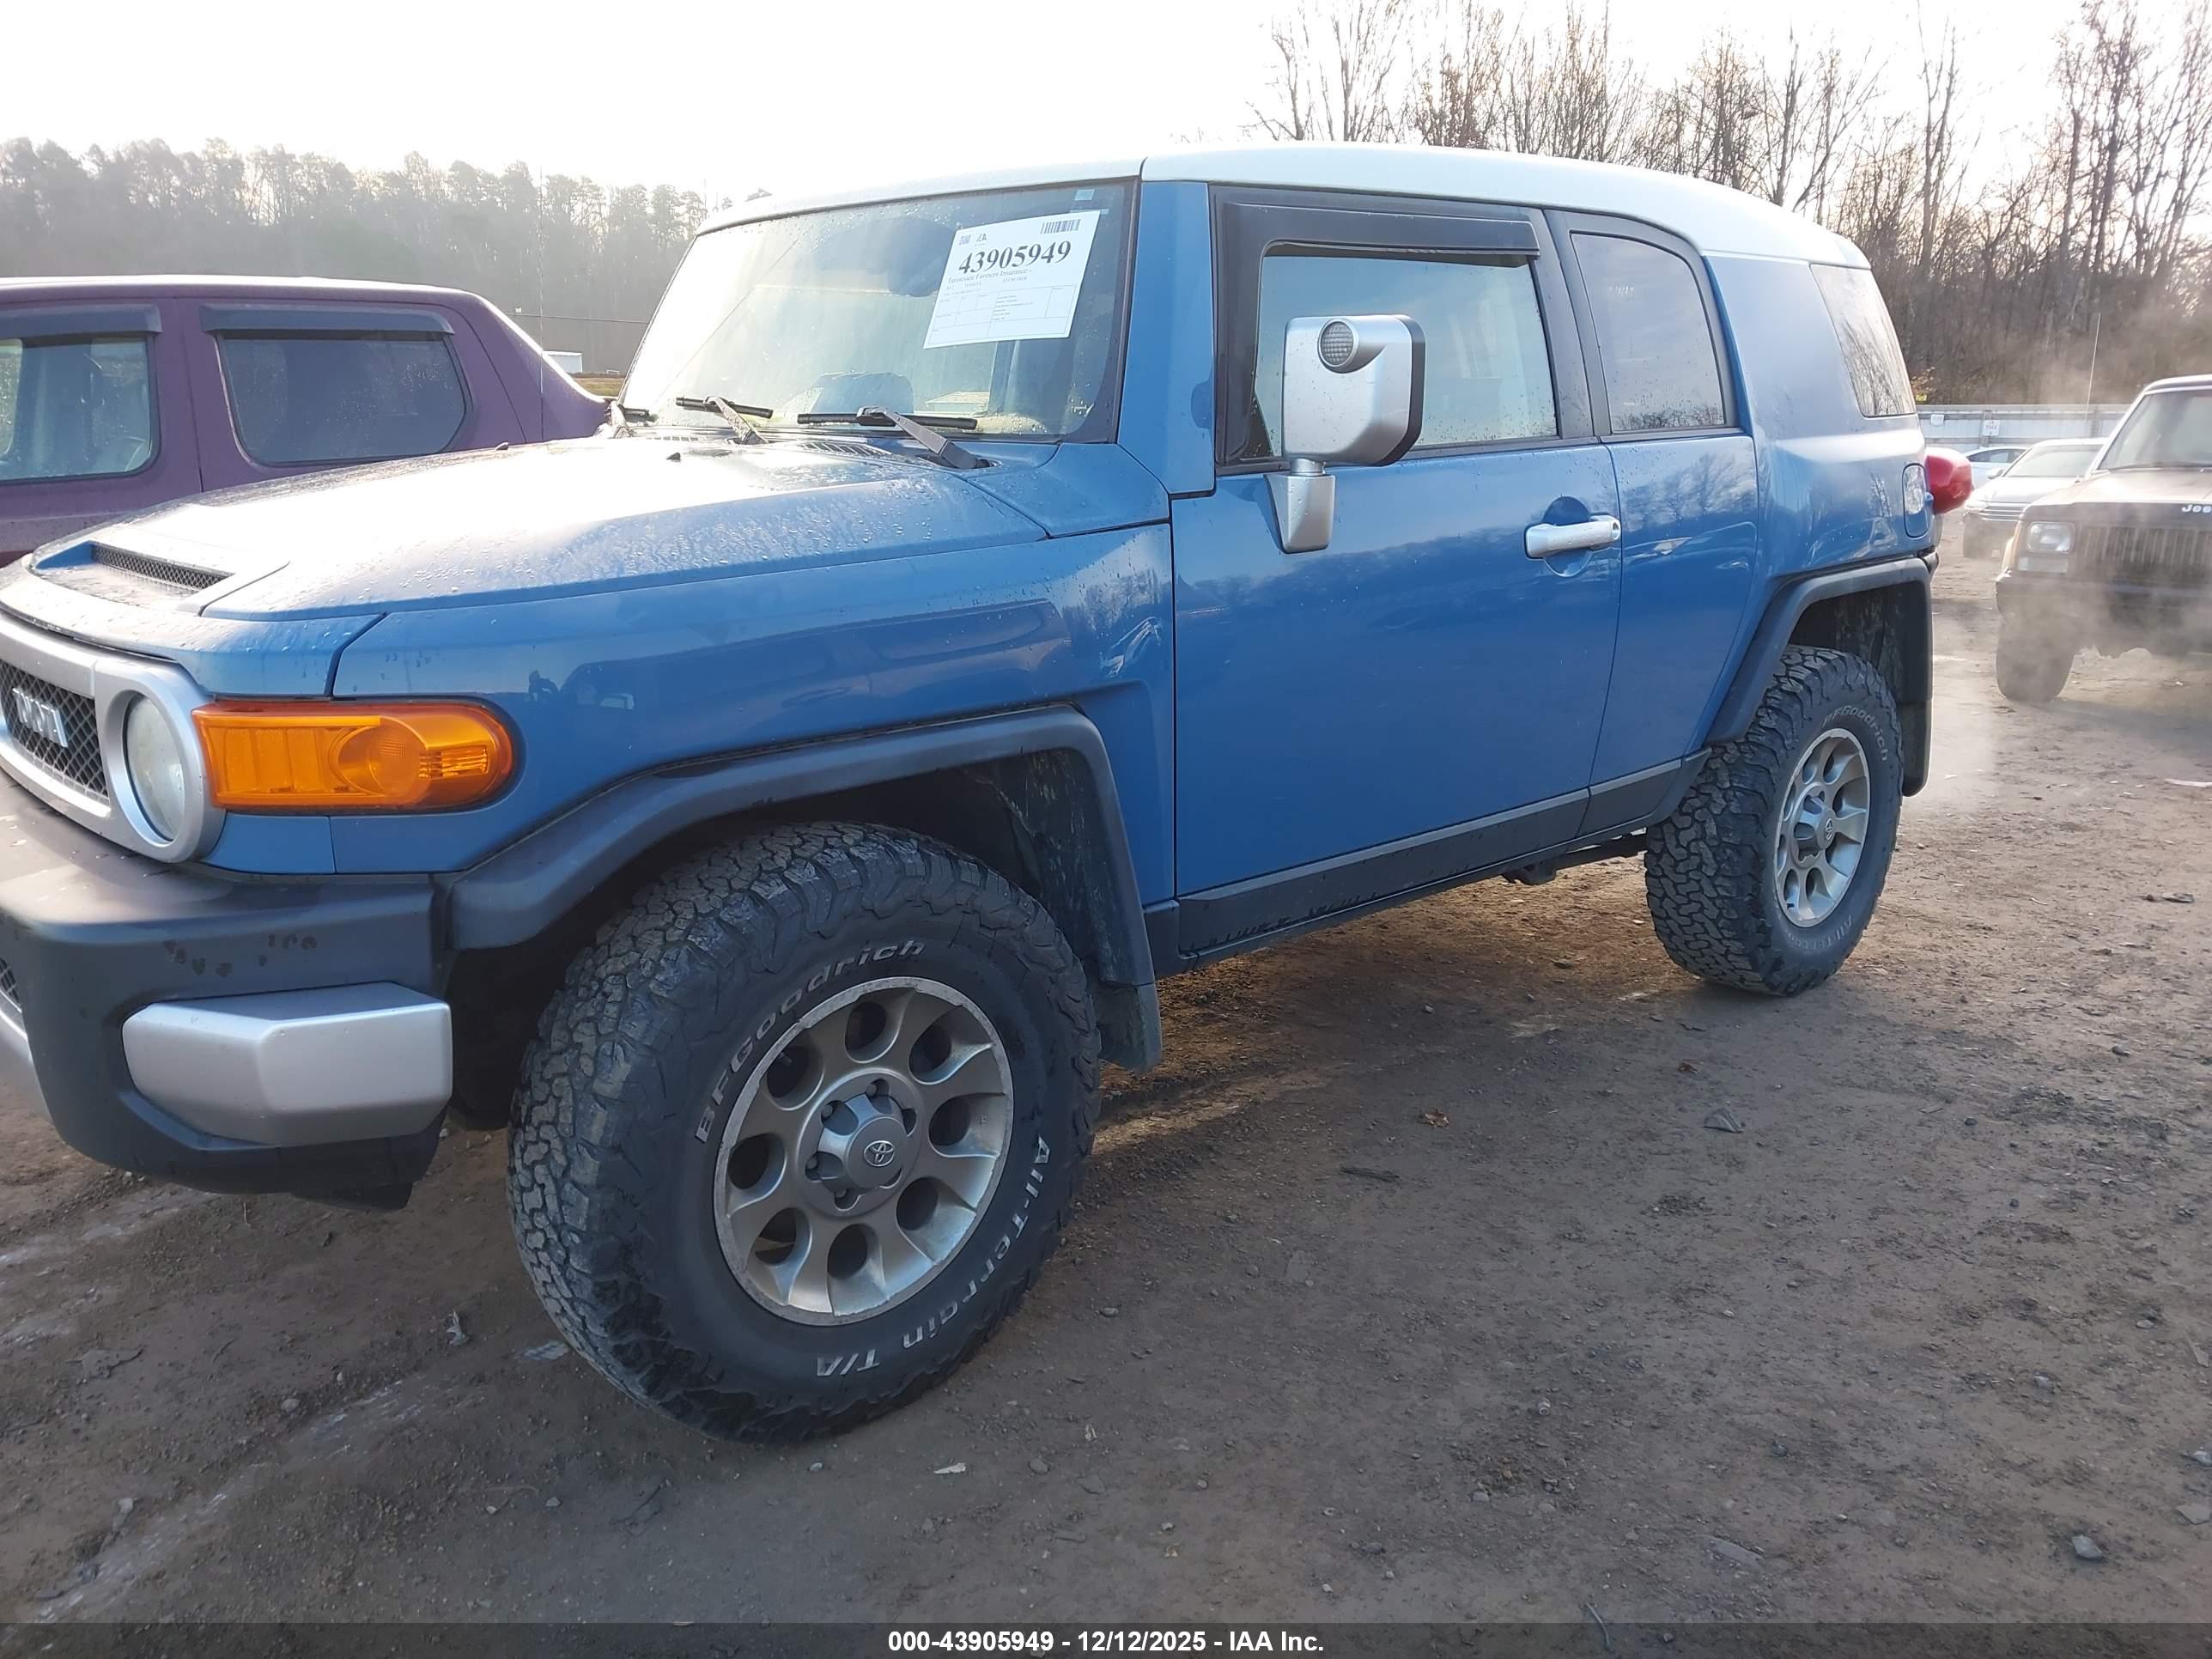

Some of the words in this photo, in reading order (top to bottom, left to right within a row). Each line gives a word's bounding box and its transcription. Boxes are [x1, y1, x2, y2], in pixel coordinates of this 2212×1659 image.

[958, 240, 1072, 274] 43905949
[695, 940, 925, 1144] BFGoodrich
[903, 1135, 1051, 1349] All-Terrain
[817, 1348, 880, 1376] T/A
